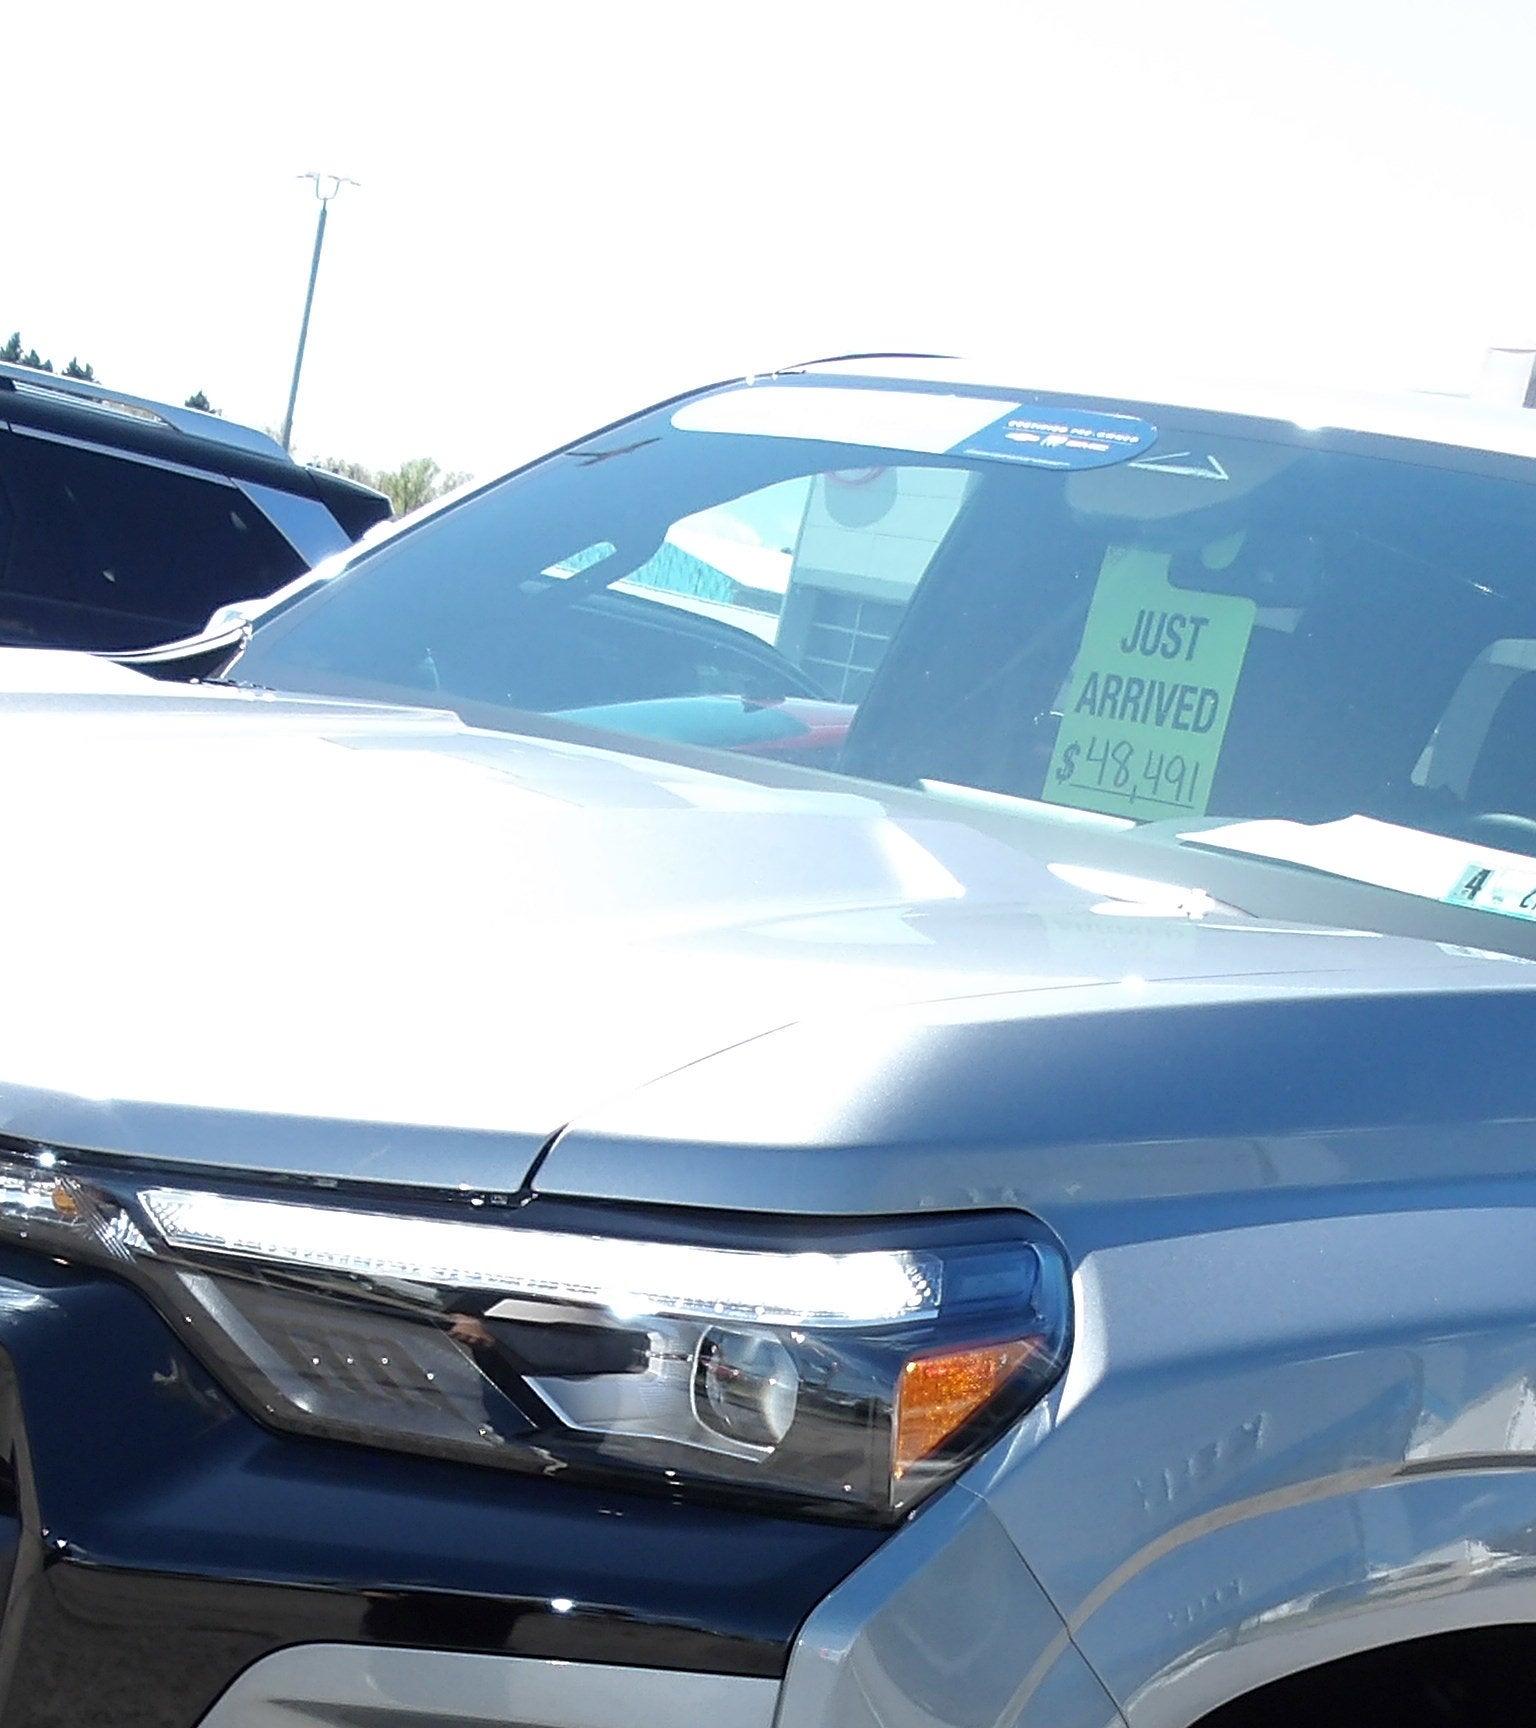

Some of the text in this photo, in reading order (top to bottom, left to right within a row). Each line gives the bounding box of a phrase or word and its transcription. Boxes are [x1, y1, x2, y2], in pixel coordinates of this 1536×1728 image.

[1120, 609, 1211, 662] JUST
[1074, 671, 1220, 734] ARRIVED
[1464, 868, 1492, 901] 4
